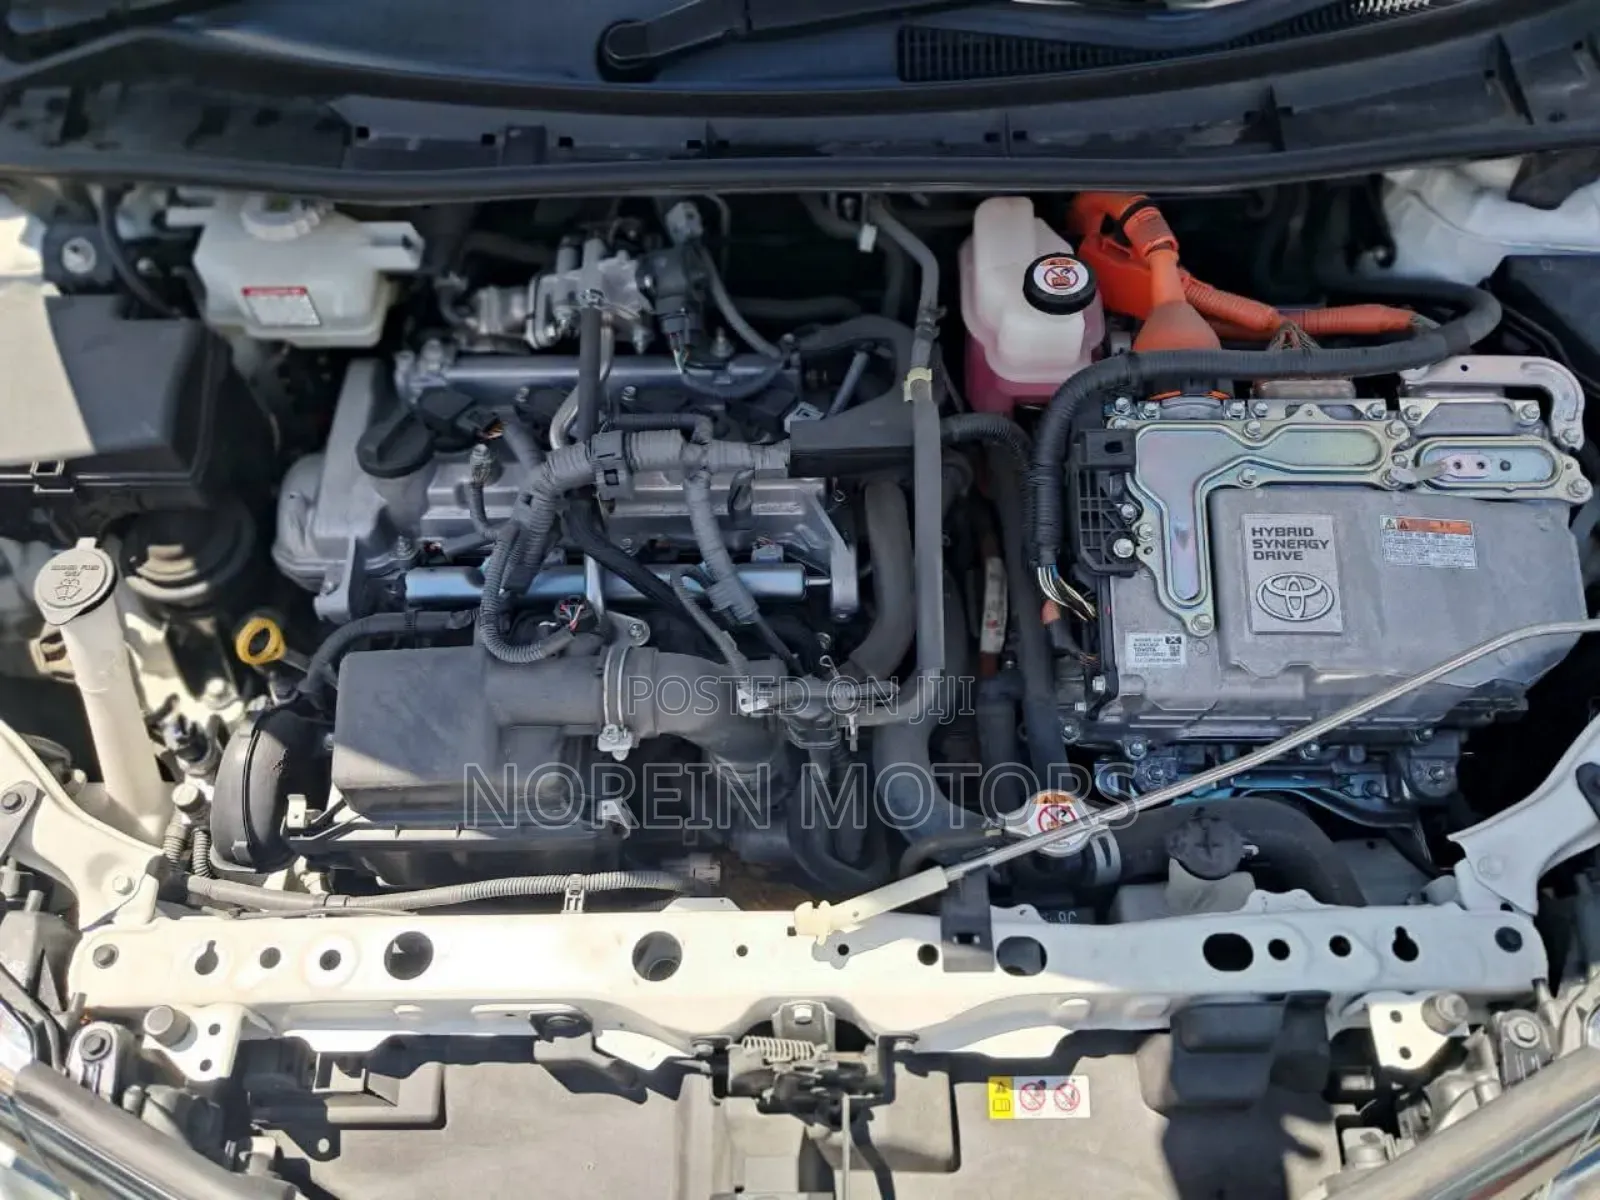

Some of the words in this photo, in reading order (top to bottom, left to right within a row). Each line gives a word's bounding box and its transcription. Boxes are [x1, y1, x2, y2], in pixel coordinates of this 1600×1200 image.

[1251, 527, 1314, 537] HYBRID
[1252, 539, 1330, 549] SYNERGY
[1253, 551, 1304, 561] DRIVE
